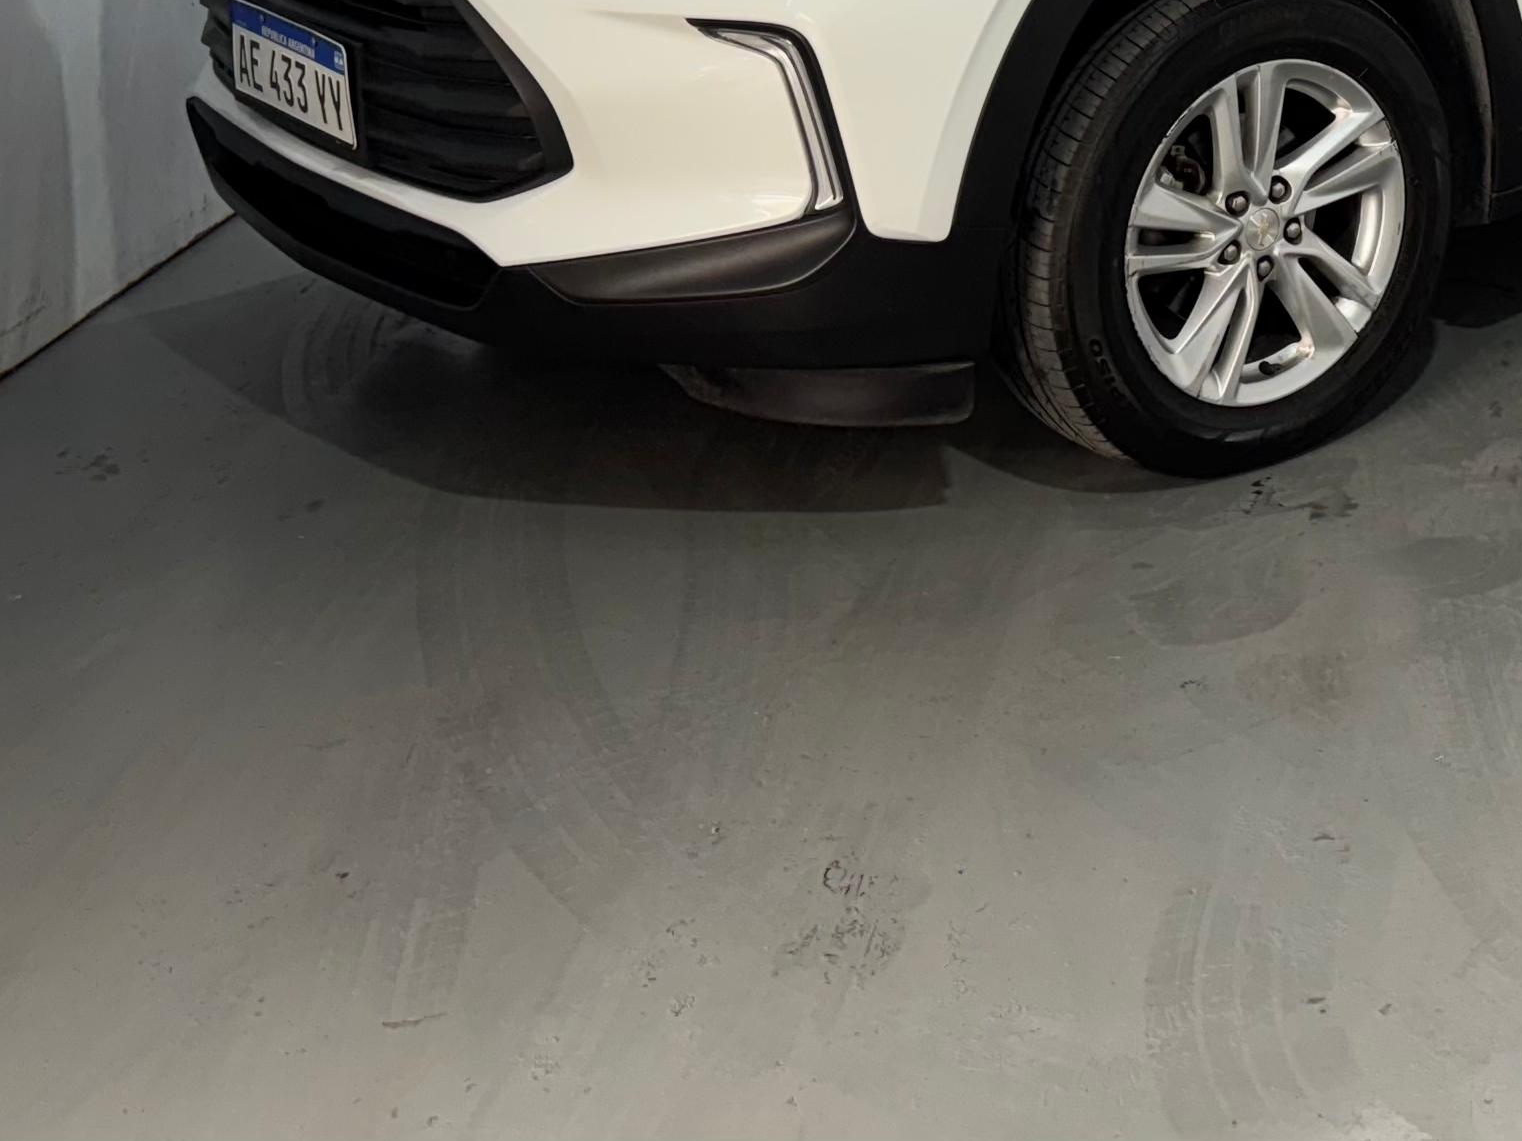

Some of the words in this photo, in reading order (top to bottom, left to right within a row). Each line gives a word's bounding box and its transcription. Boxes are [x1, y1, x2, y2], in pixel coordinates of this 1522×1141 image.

[239, 34, 264, 93] AE
[269, 50, 309, 114] 433
[315, 69, 344, 131] YY
